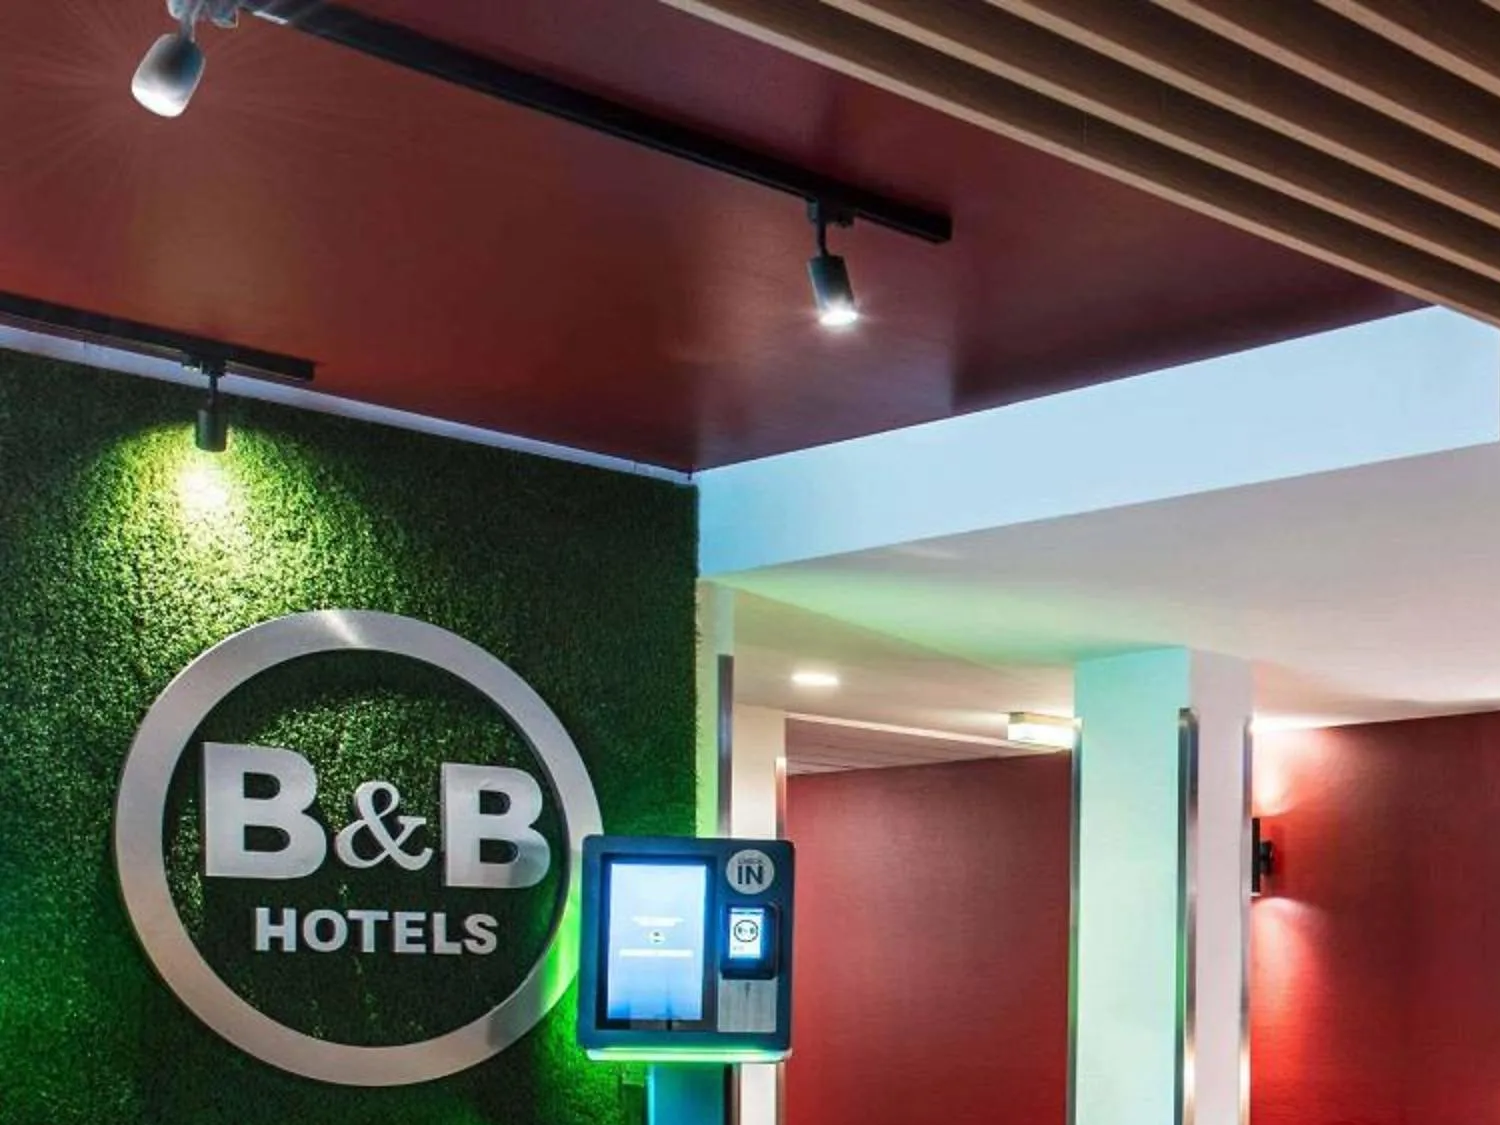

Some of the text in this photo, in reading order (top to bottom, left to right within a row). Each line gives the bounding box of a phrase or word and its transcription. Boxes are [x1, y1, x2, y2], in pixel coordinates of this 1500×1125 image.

[203, 742, 551, 888] B&B
[737, 865, 763, 885] IN
[255, 907, 499, 955] HOTELS
